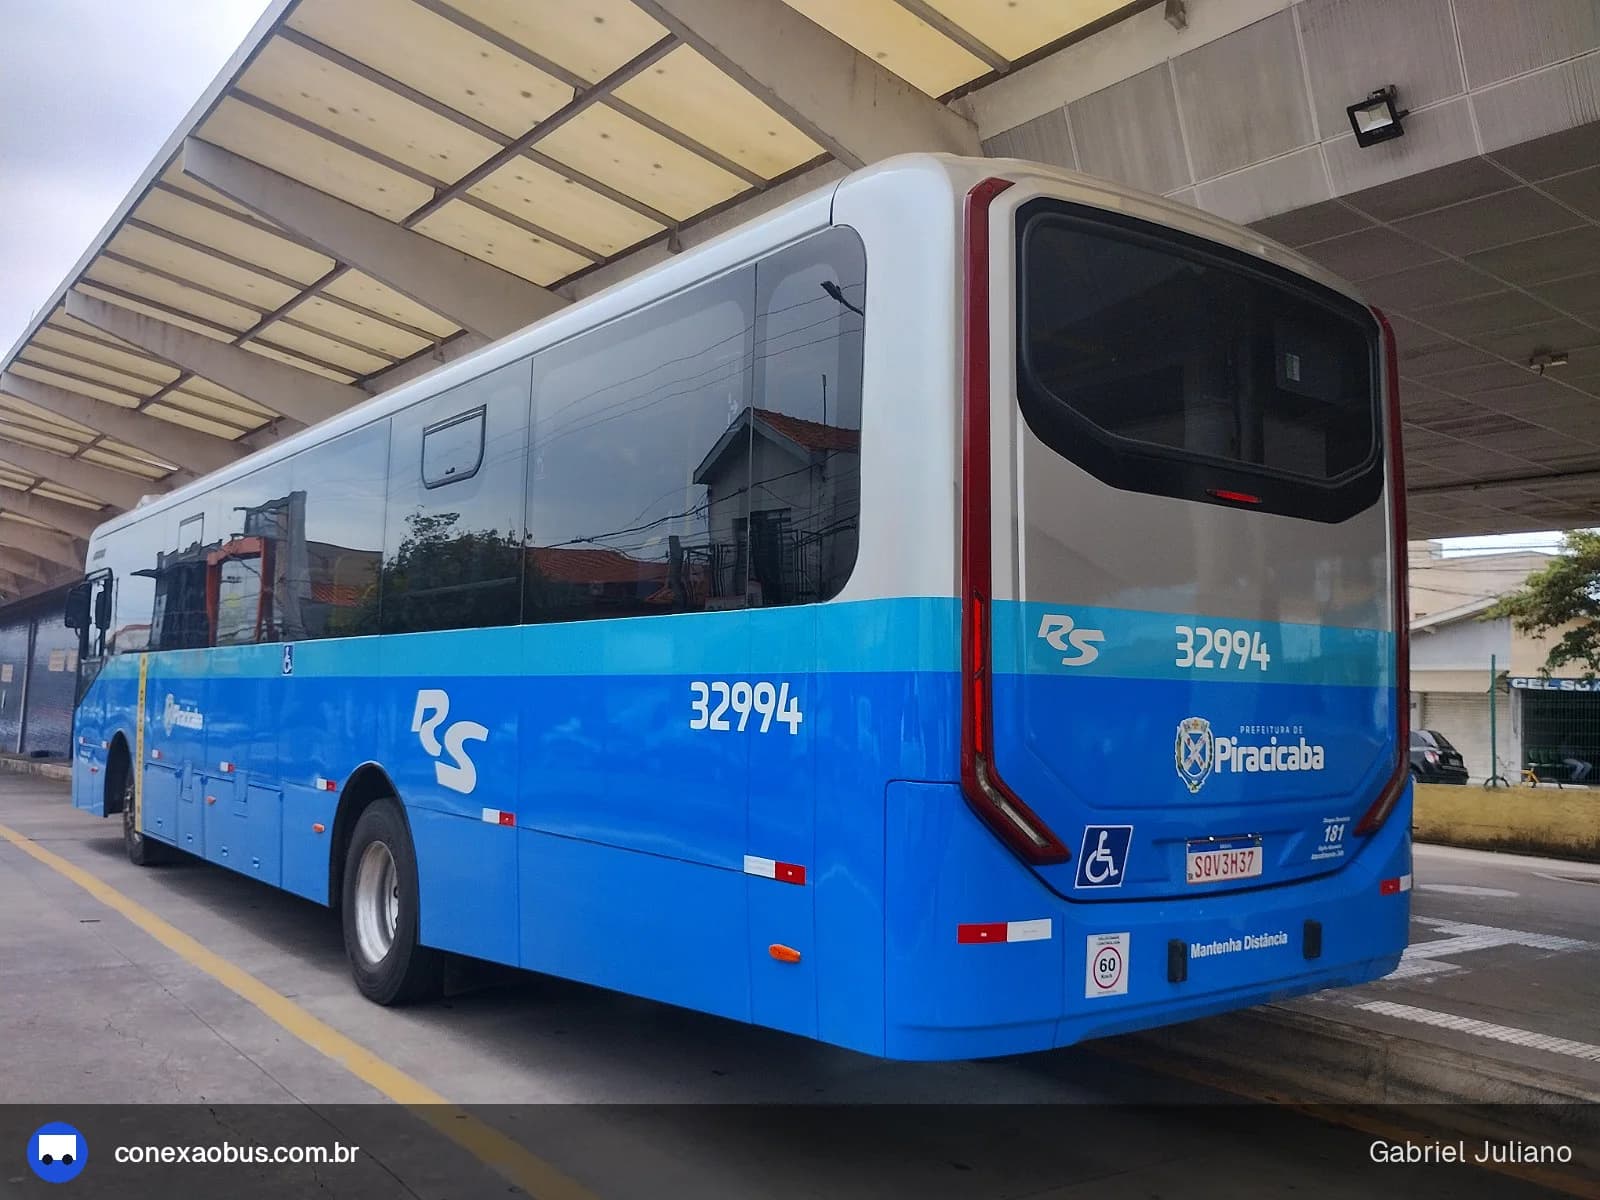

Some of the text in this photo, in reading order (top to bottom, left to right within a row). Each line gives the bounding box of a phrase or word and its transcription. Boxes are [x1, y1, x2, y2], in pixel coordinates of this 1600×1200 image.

[1037, 614, 1105, 666] RS
[1175, 625, 1270, 671] 32994
[690, 681, 803, 735] 32994
[411, 689, 489, 794] RS
[1239, 725, 1304, 735] PREFEITURA DE
[1214, 736, 1325, 773] Piracicaba
[1324, 823, 1345, 843] 181
[1194, 850, 1254, 878] SQV3H37
[1190, 930, 1288, 959] Mantenha Distância
[1100, 957, 1116, 973] 60
